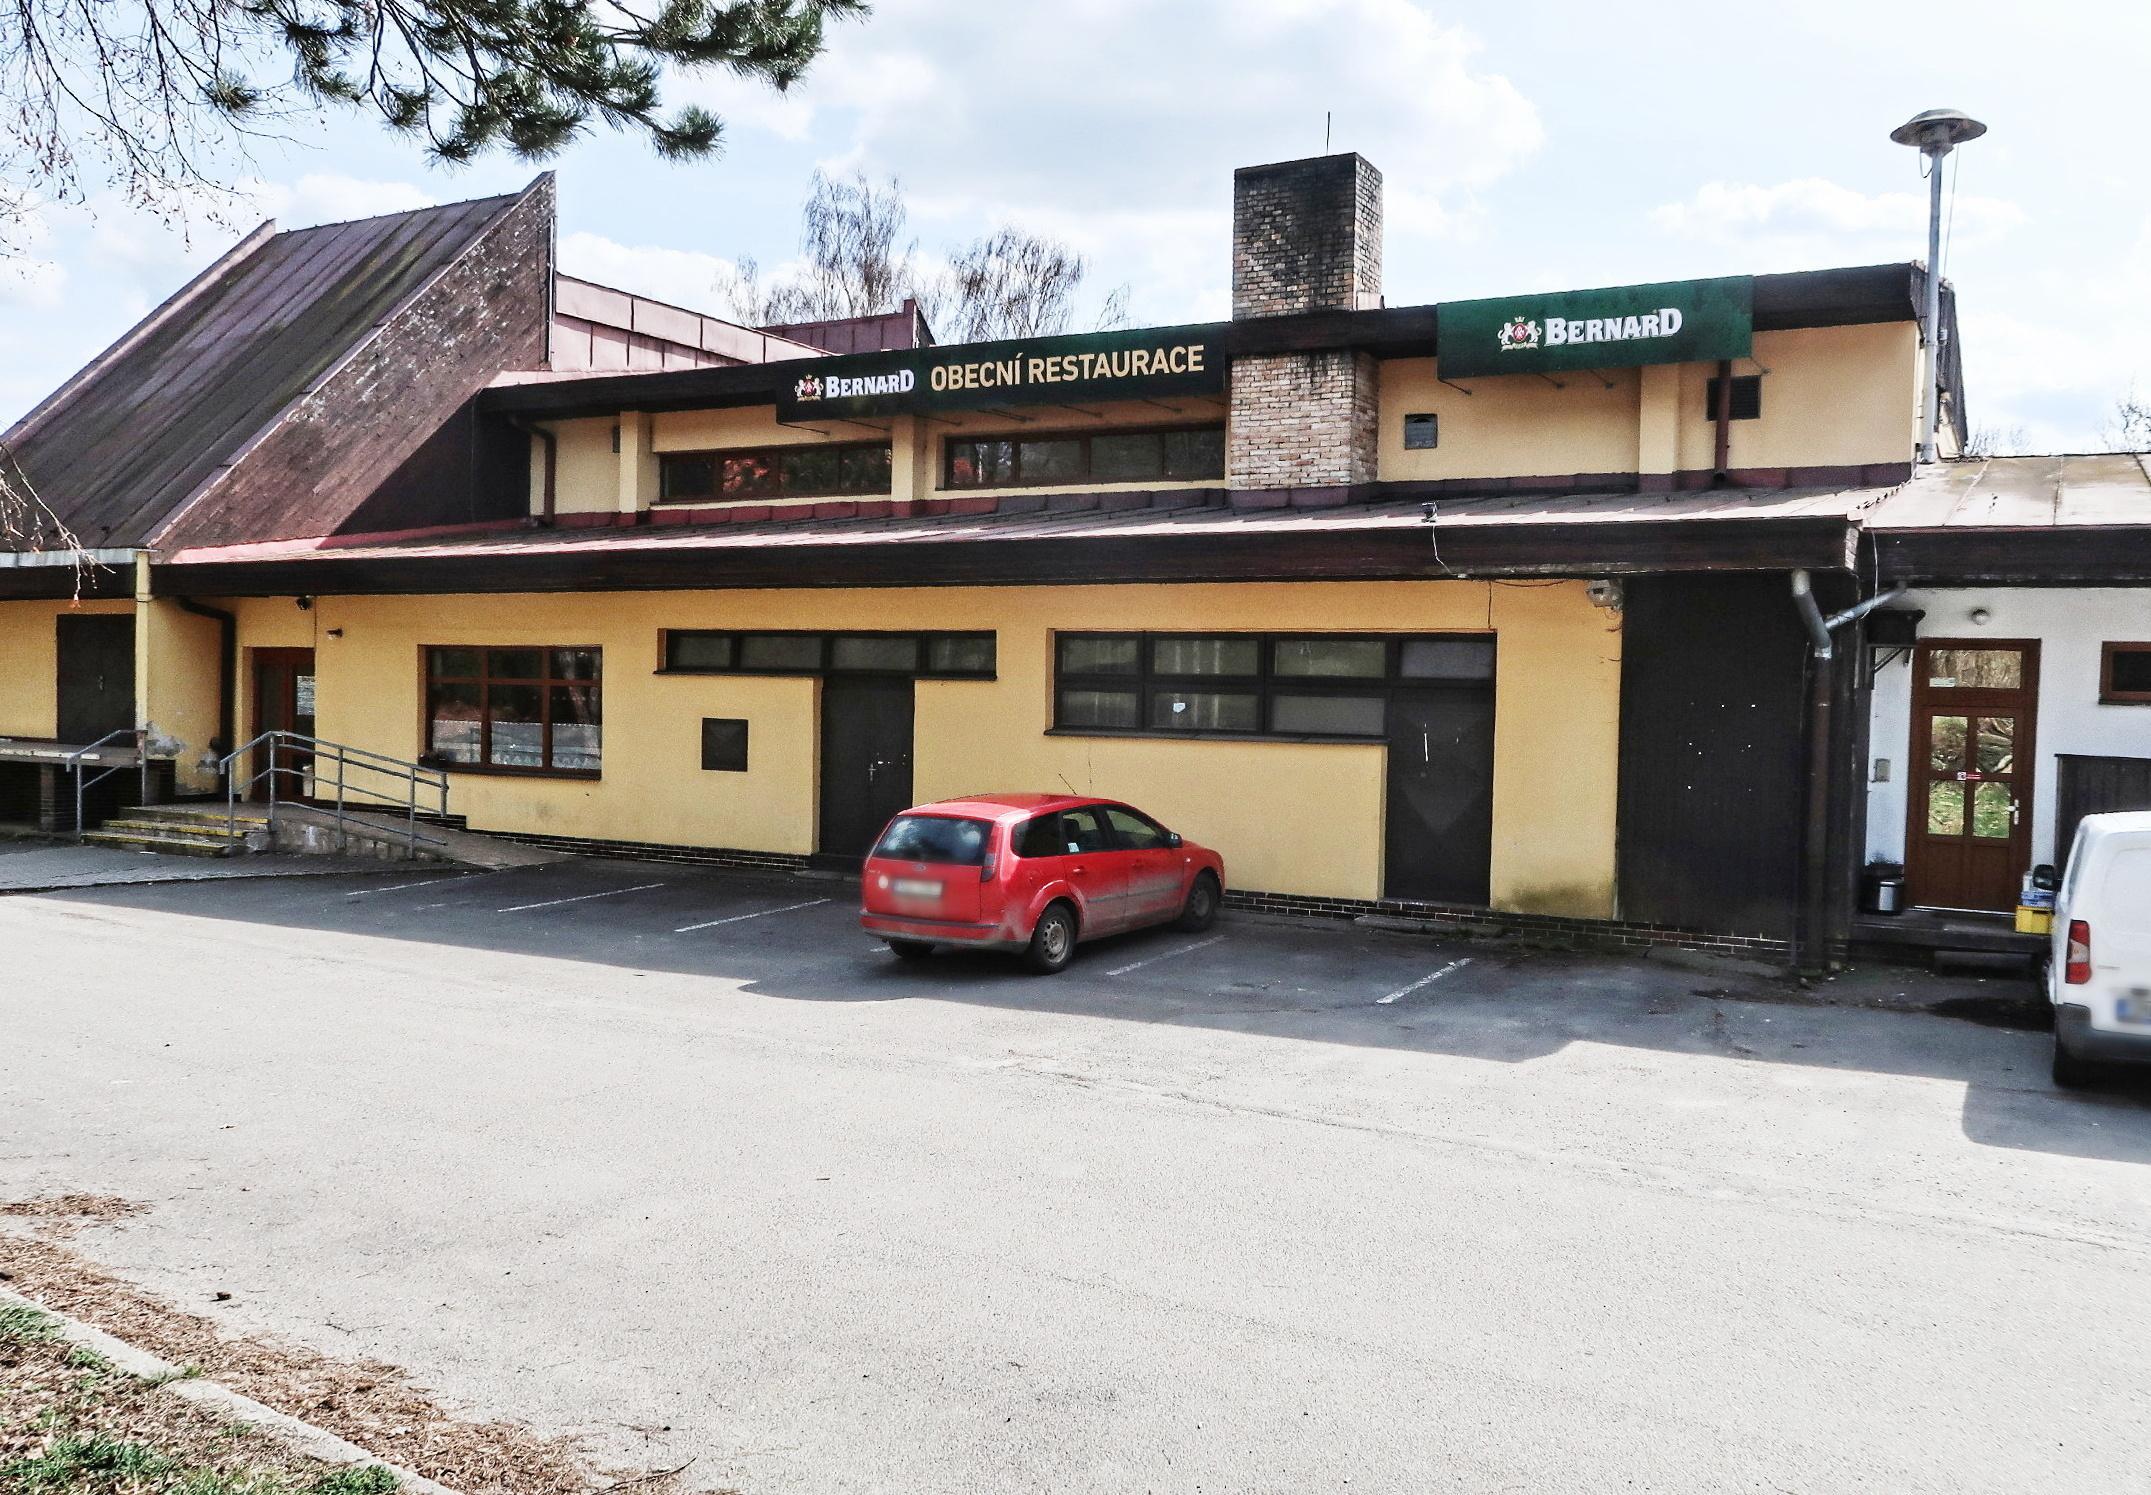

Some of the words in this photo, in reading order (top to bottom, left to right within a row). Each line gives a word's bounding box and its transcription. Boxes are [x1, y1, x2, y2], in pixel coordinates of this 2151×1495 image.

[1544, 308, 1683, 346] BERNARD
[825, 369, 915, 398] BERNARD
[930, 352, 1024, 391] OBECNÍ
[1028, 345, 1205, 384] RESTAURACE
